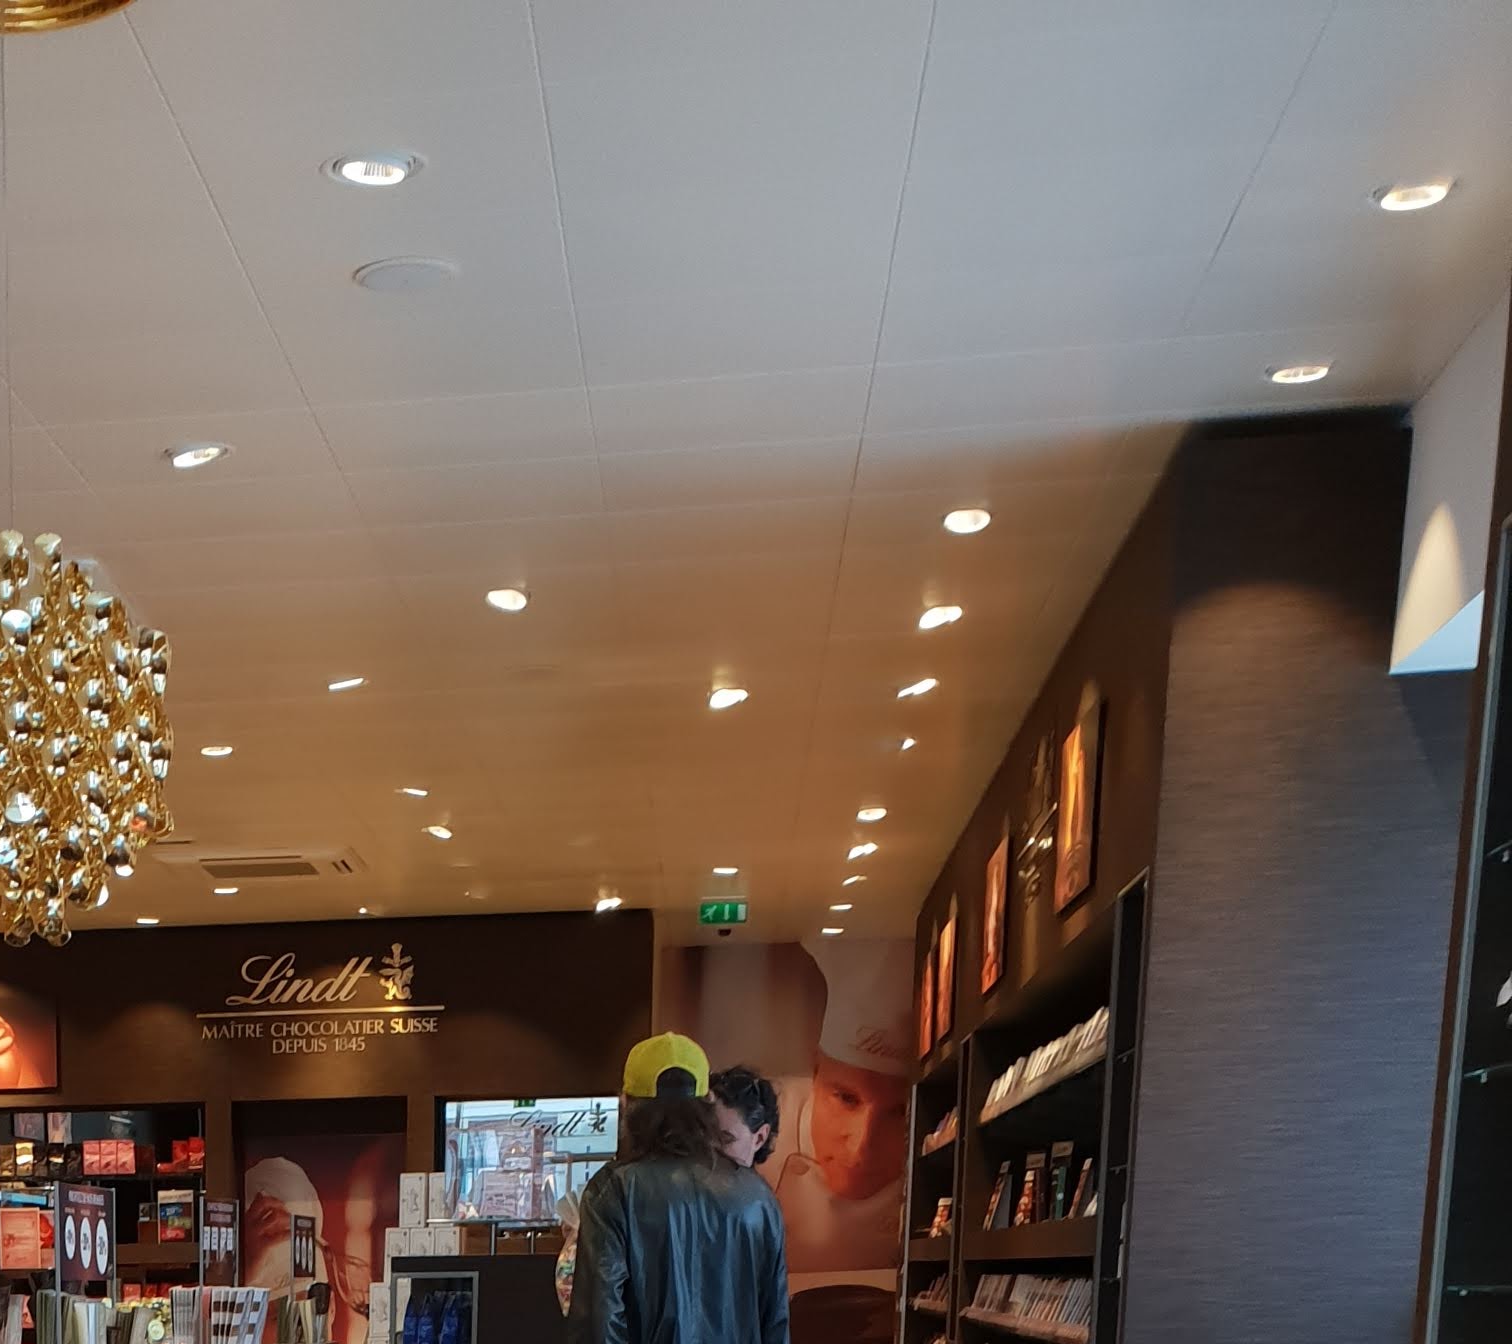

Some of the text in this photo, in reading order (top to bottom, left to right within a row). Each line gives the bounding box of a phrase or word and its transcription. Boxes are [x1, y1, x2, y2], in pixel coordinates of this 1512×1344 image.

[225, 953, 373, 1005] Lindt
[201, 1018, 438, 1039] MAÎTRE CHOCOLATIER SUISSE
[272, 1037, 365, 1054] DEPUIS 1845
